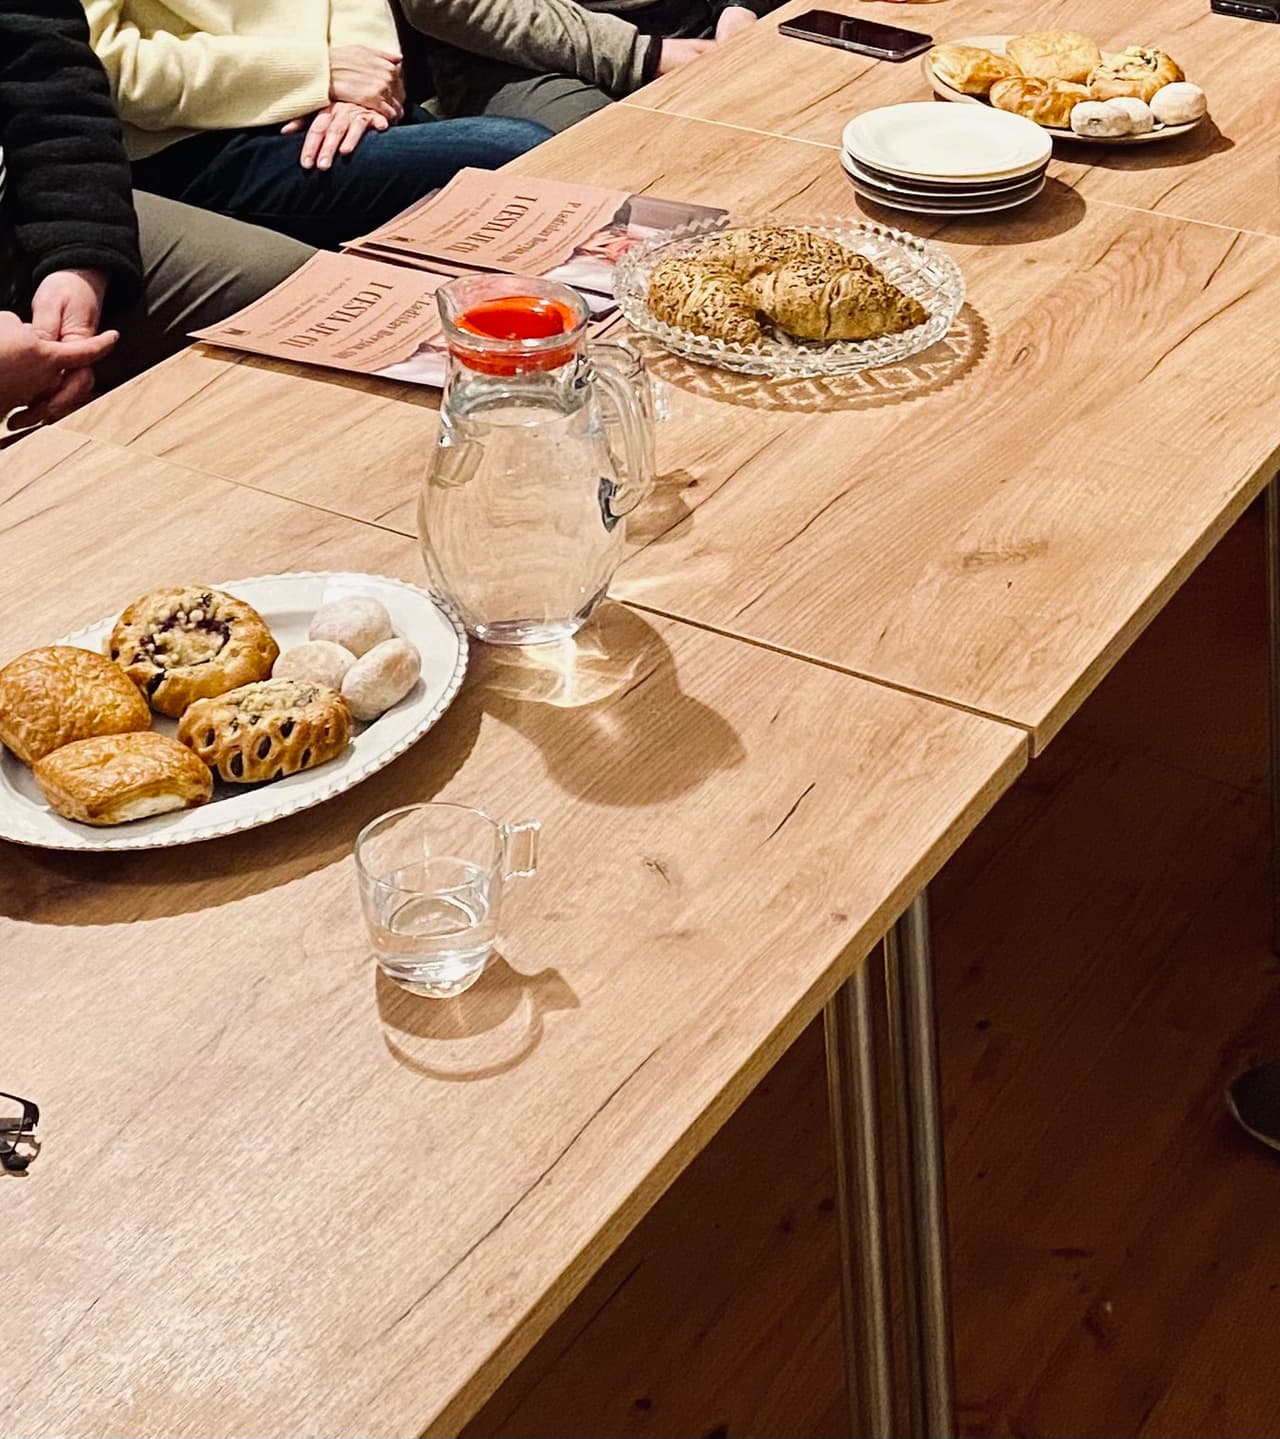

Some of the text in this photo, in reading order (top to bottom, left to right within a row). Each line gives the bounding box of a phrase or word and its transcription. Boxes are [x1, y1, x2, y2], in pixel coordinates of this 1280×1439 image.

[480, 203, 530, 232] CESTA
[464, 231, 497, 243] JE
[325, 290, 383, 323] CESTA
[304, 321, 340, 336] JE
